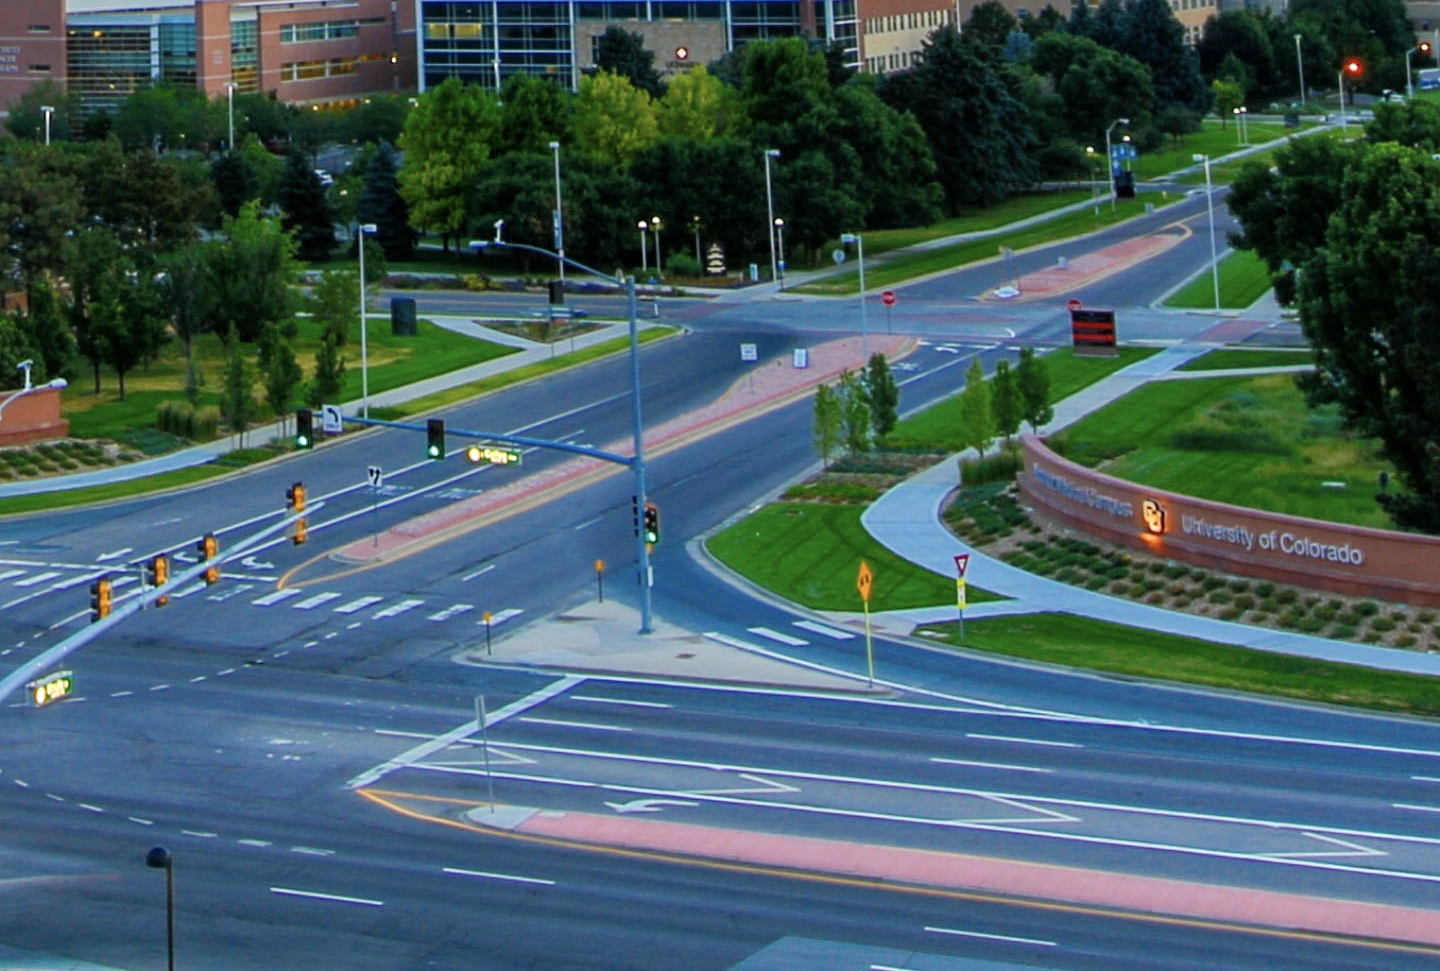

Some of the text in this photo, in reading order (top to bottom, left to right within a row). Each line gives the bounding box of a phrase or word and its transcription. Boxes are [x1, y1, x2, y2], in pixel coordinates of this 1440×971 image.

[1181, 514, 1363, 566] University of Colorado
